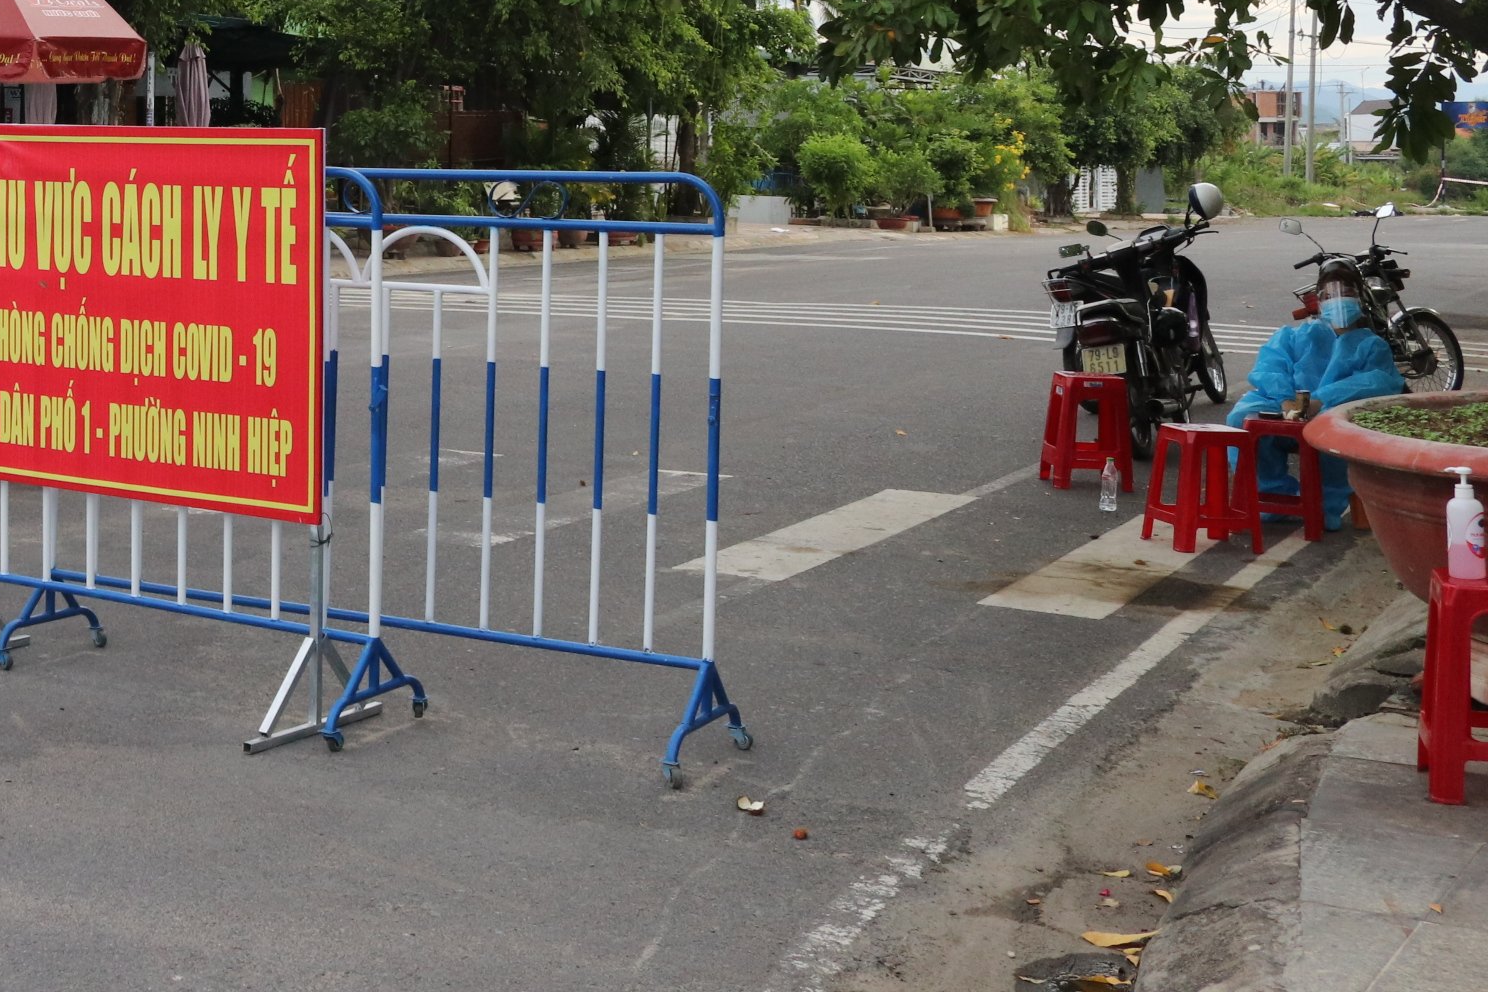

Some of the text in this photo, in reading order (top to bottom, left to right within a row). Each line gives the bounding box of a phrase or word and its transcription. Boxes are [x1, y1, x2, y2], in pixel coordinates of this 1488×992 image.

[34, 167, 92, 290] VỰC
[101, 168, 182, 279] CÁCH
[193, 185, 224, 281] LY
[232, 186, 252, 282] Y
[261, 153, 297, 285] TẾ
[51, 296, 114, 372] CHỐNG
[120, 318, 167, 386] DỊCH
[172, 322, 233, 383] COVID
[252, 328, 277, 387] 19
[0, 382, 35, 447] DÂN
[40, 379, 76, 453] PHỐ
[81, 400, 91, 454] 1
[109, 396, 186, 466] PHƯỜNG
[192, 411, 241, 472] NINH
[247, 408, 293, 488] HIỆP
